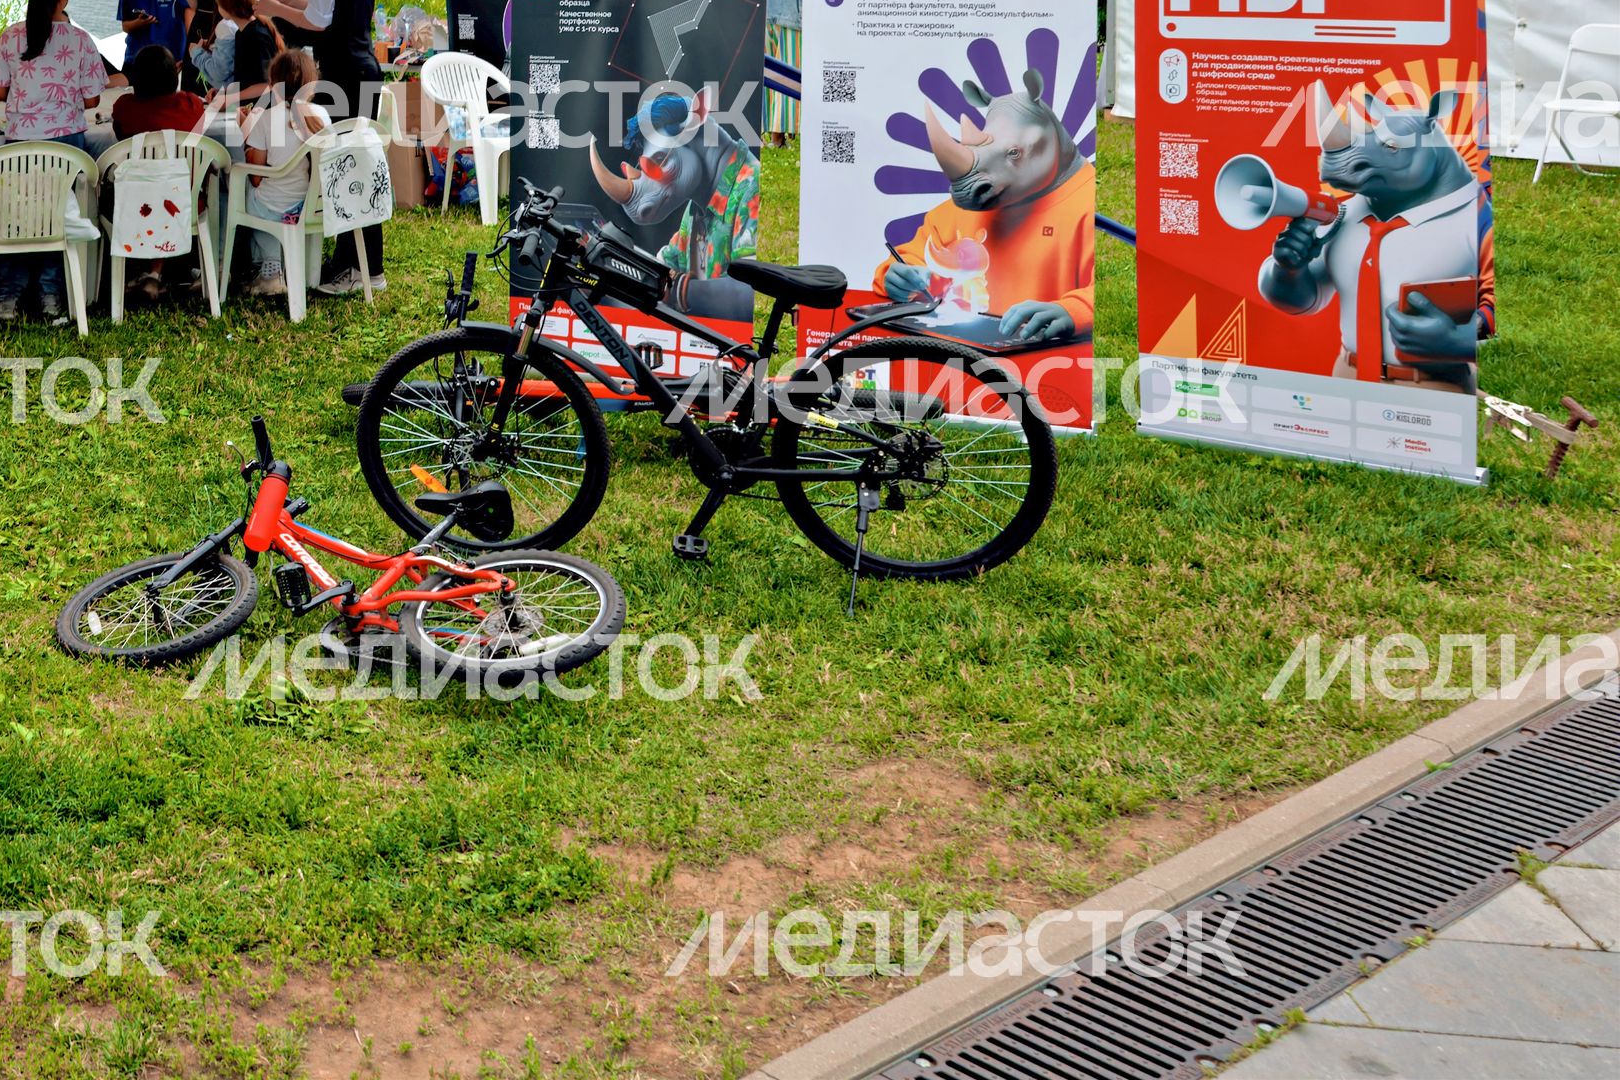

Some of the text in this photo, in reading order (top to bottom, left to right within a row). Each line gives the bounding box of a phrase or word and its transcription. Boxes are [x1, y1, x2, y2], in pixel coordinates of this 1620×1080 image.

[868, 1, 907, 10] партнёра
[959, 1, 996, 10] ведущей
[857, 9, 917, 17] анимационной
[919, 10, 968, 18] киностудии
[559, 26, 574, 34] уже
[598, 26, 619, 34] курса
[857, 21, 896, 30] Практика
[904, 22, 955, 30] стажировки
[869, 30, 906, 38] проектах
[1192, 52, 1381, 66] Научись создавать креативные решения
[1192, 61, 1208, 70] для
[1211, 62, 1273, 71] продвижения
[1276, 63, 1313, 72] бизнеса
[1323, 65, 1364, 75] брендов
[1199, 70, 1245, 80] цифровой
[1247, 72, 1275, 81] среде
[1196, 82, 1291, 92] Диплом государственного
[1196, 98, 1249, 106] Убедительное
[1219, 106, 1250, 114] первого
[575, 300, 631, 360] DENTON
[1201, 367, 1258, 380] факультета
[1396, 414, 1432, 426] KISLOROD
